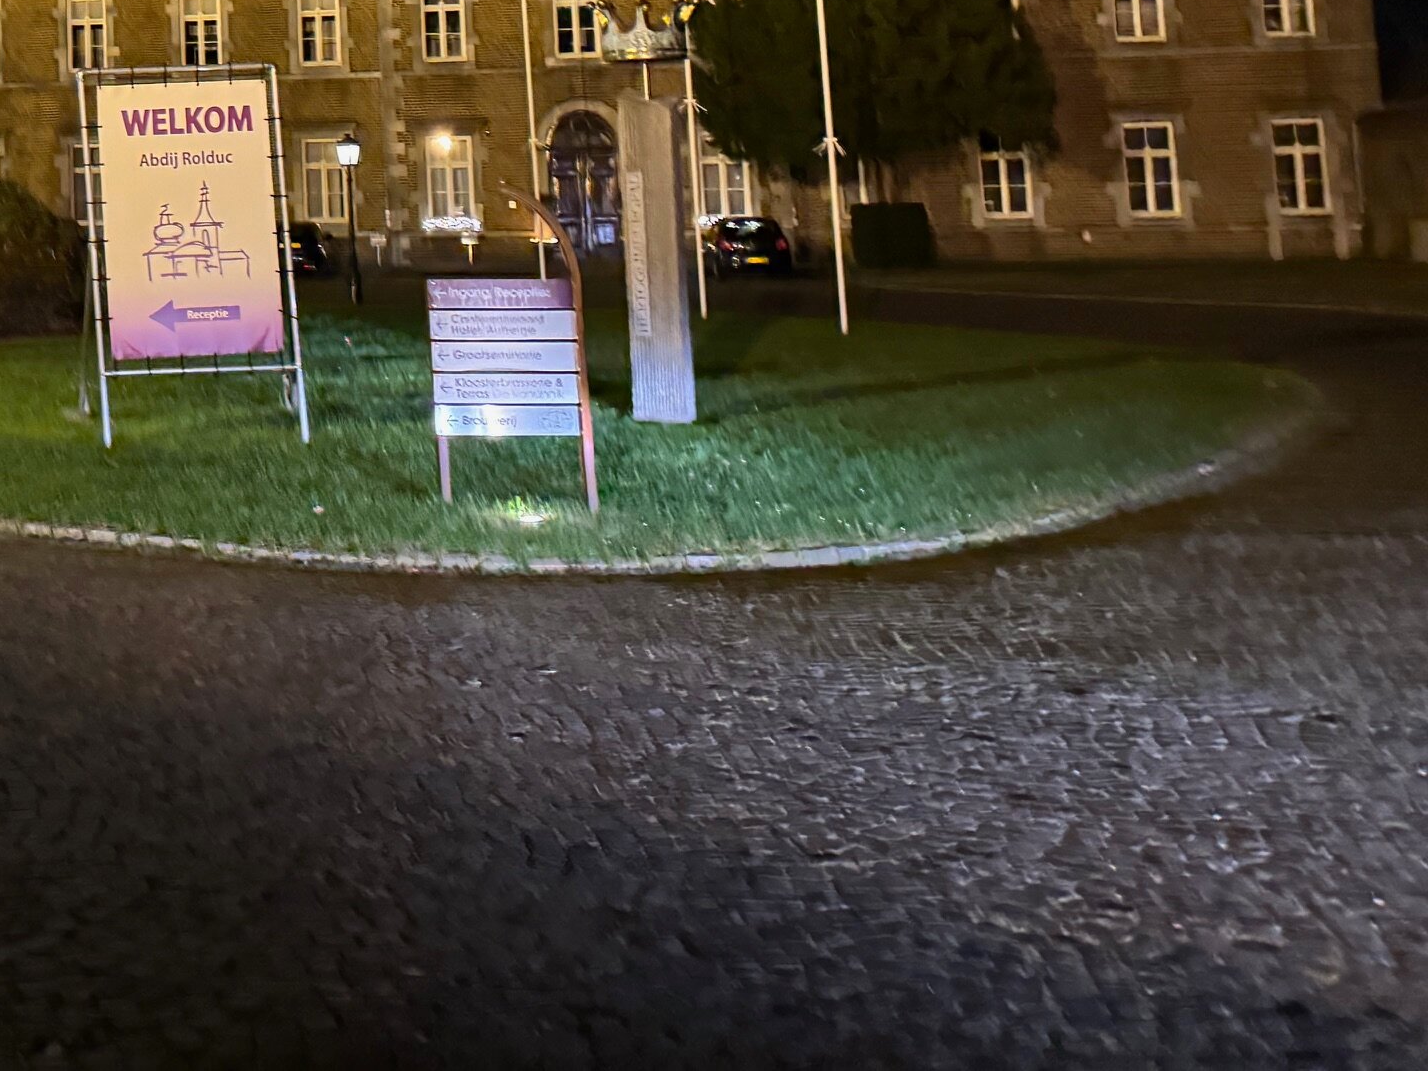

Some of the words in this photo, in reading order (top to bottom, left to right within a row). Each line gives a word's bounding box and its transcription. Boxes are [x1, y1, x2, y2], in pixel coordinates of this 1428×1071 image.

[121, 105, 254, 137] WELKOM
[139, 152, 179, 170] Abdij
[183, 150, 234, 166] Rolduc
[187, 308, 229, 322] Receptie
[555, 378, 564, 388] &
